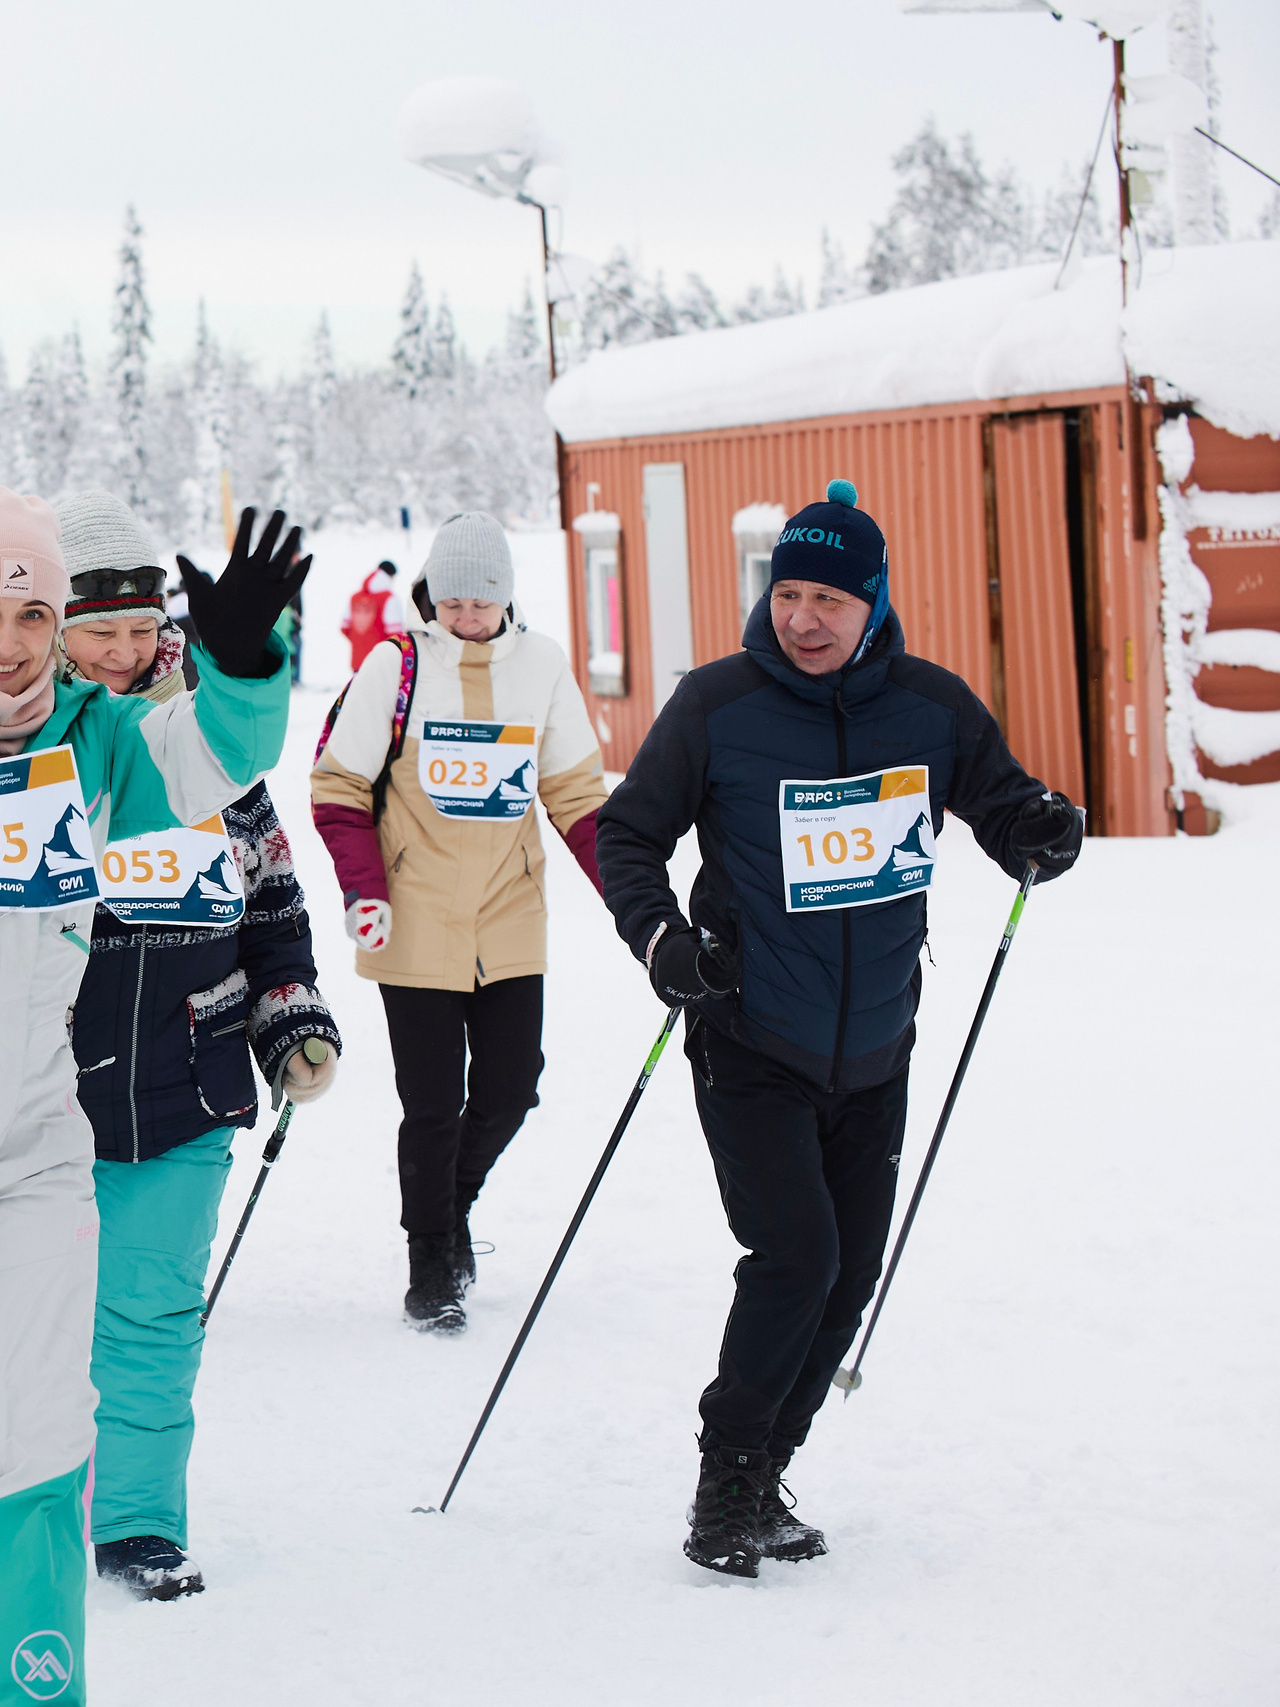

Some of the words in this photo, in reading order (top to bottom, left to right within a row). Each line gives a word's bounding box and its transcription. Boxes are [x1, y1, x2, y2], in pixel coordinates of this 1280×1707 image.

[431, 727, 463, 737] ВАРС
[428, 759, 488, 787] 023
[794, 790, 834, 804] ВАРС
[796, 827, 875, 867] 103
[102, 849, 180, 884] 053
[800, 879, 874, 895] КОВДОРСКИЙ
[801, 894, 824, 902] ГОК
